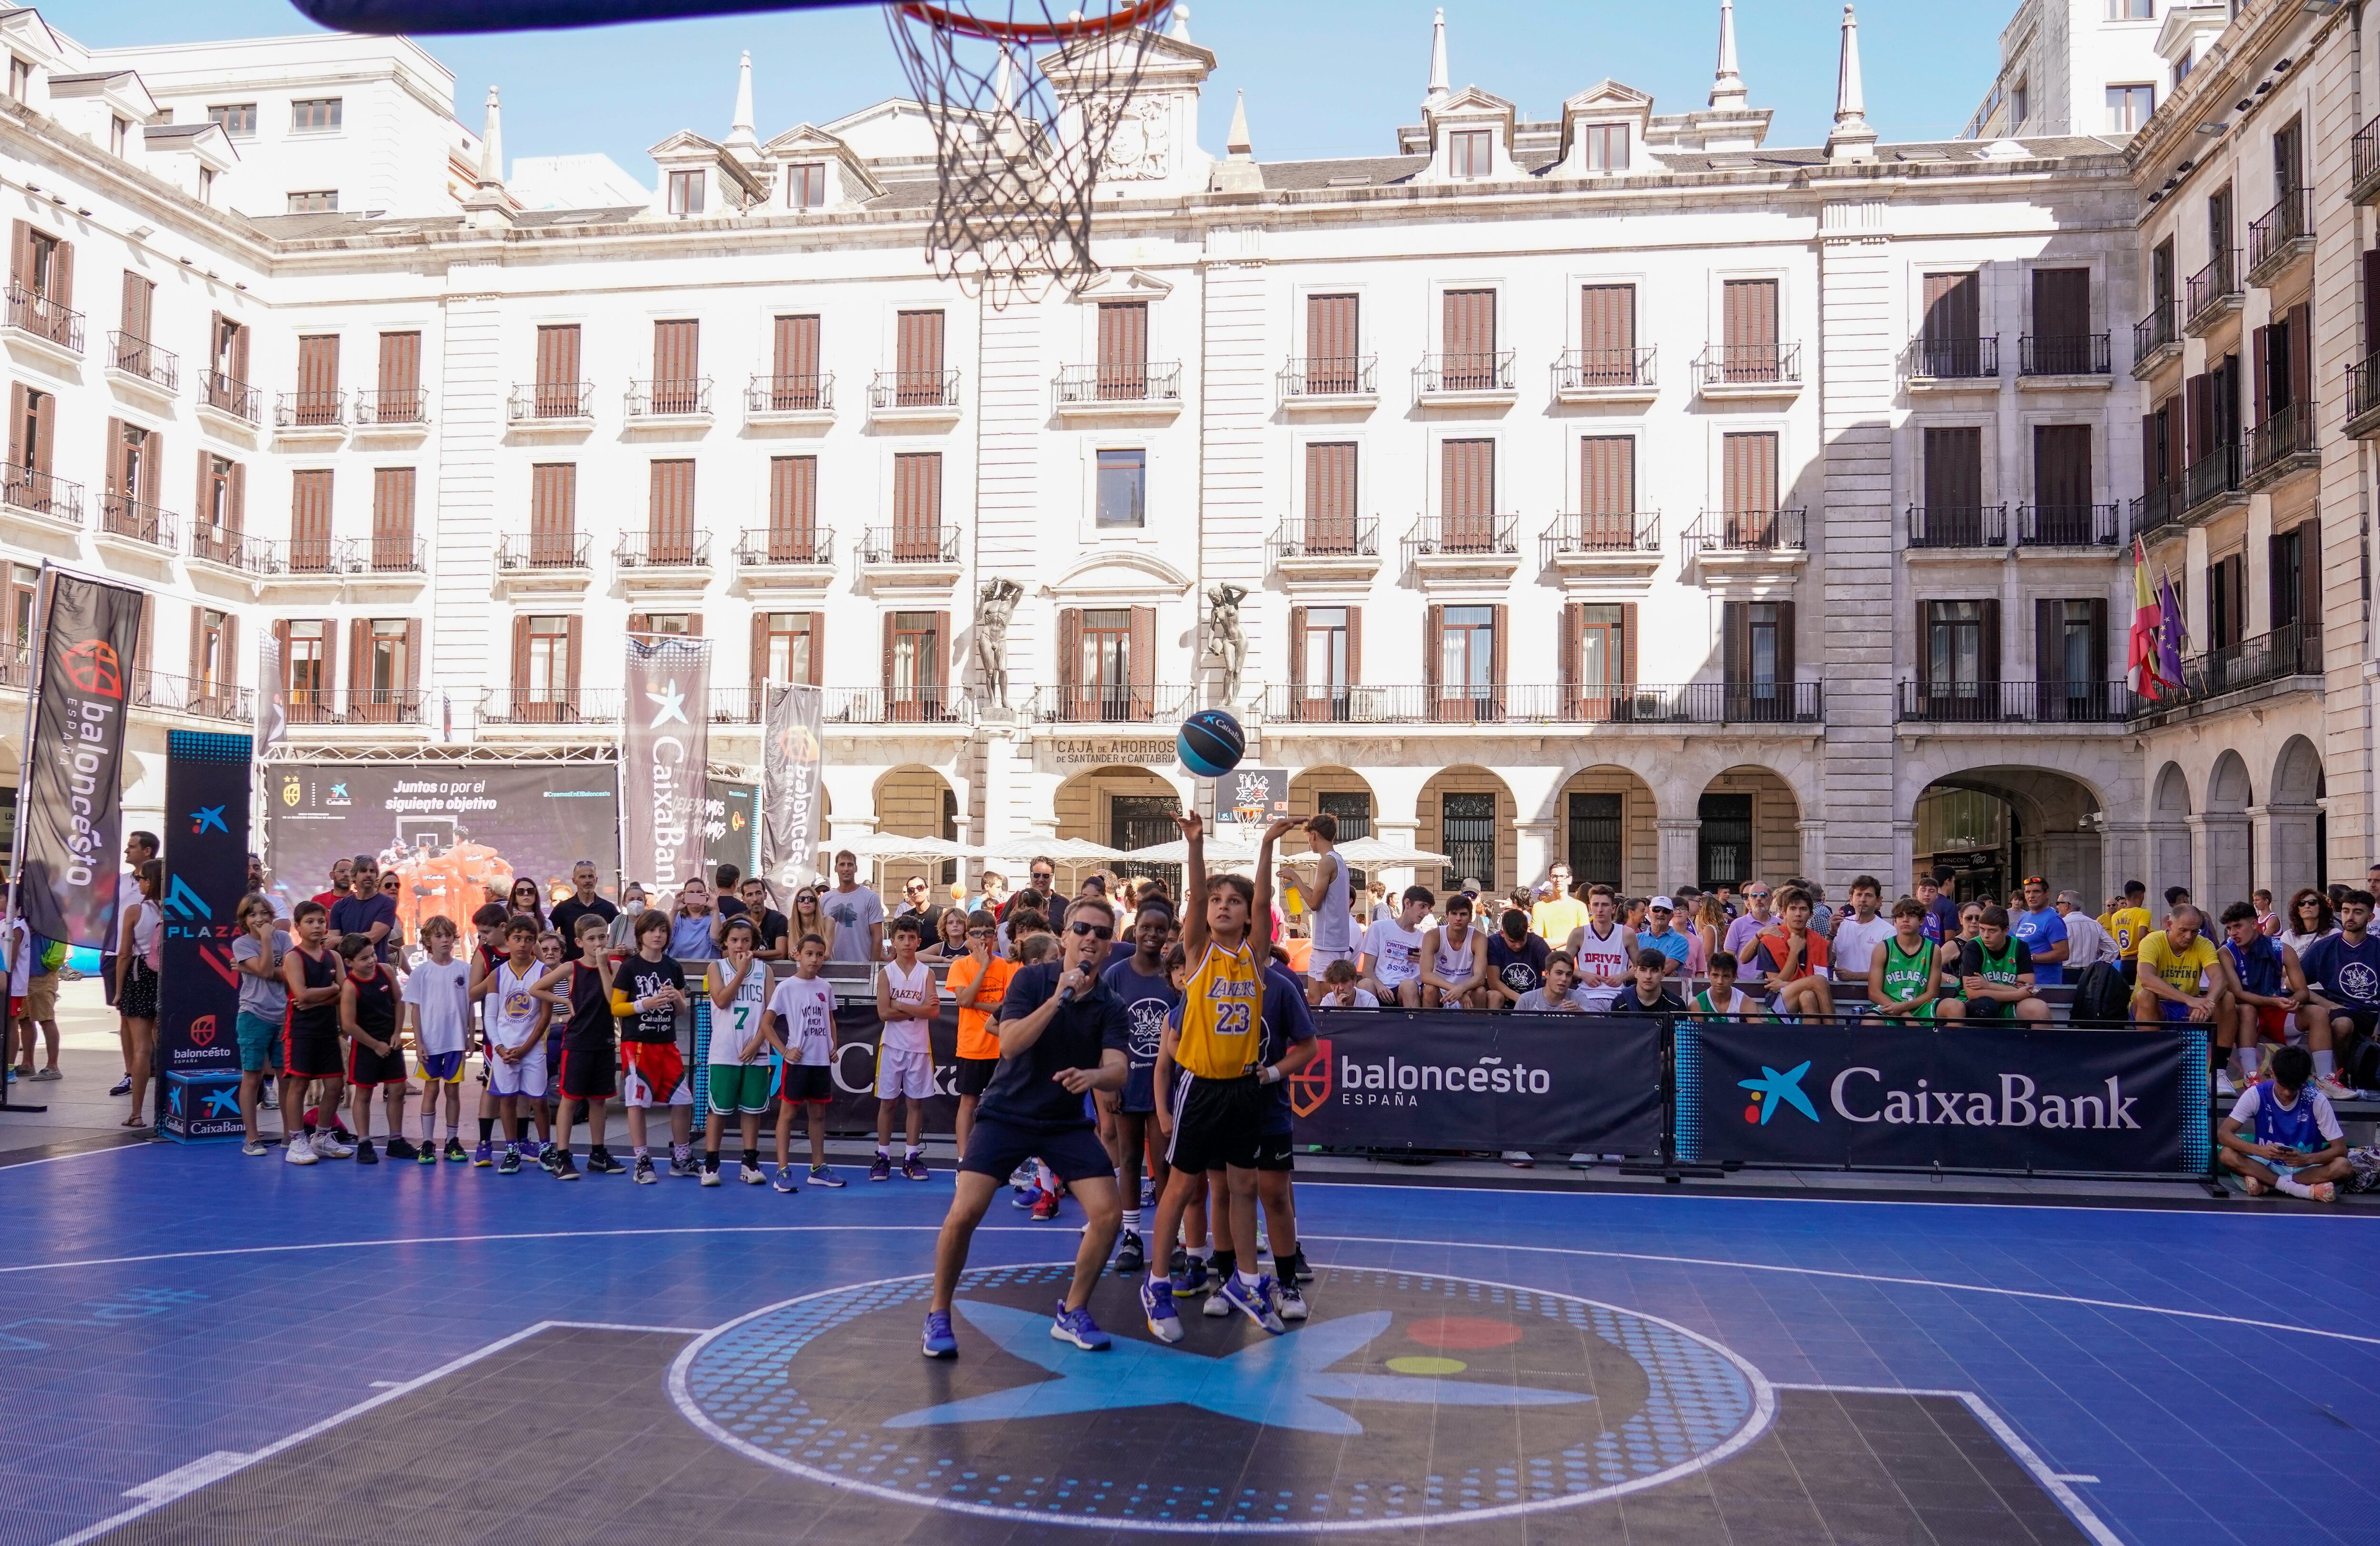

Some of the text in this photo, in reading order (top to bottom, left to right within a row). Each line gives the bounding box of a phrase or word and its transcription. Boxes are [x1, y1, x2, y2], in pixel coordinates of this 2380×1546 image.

[59, 698, 78, 765] ESPAÑA
[1058, 741, 1093, 753] CAJA
[1111, 741, 1175, 753] AHORROS
[1128, 754, 1175, 762] CANTABRIA
[393, 780, 486, 796] Juntos a por el
[385, 797, 497, 813] siguiente objetivo
[653, 736, 686, 903] CaixaBank
[1971, 853, 1986, 864] Teo
[1926, 916, 1936, 928] 00
[168, 926, 244, 938] PLAZA
[2118, 928, 2130, 950] 6
[1387, 942, 1409, 951] CANTBAS
[1585, 953, 1621, 964] DRIVE
[1596, 963, 1608, 977] 11
[1885, 970, 1928, 987] PIELAGS
[1983, 971, 2017, 985] IELAGO
[734, 984, 763, 1003] LTICS
[891, 988, 922, 1001] LAKERS
[1206, 977, 1257, 999] LAKERS
[1900, 987, 1915, 1001] 5
[516, 995, 528, 1005] 30
[734, 1007, 749, 1030] 7
[813, 1007, 823, 1016] HA
[1215, 1002, 1251, 1035] 23
[174, 1047, 231, 1058] baloncesto
[1342, 1055, 1550, 1094] baloncesto
[1342, 1092, 1418, 1106] ESPAÑA
[1830, 1067, 2142, 1129] CaixaBank
